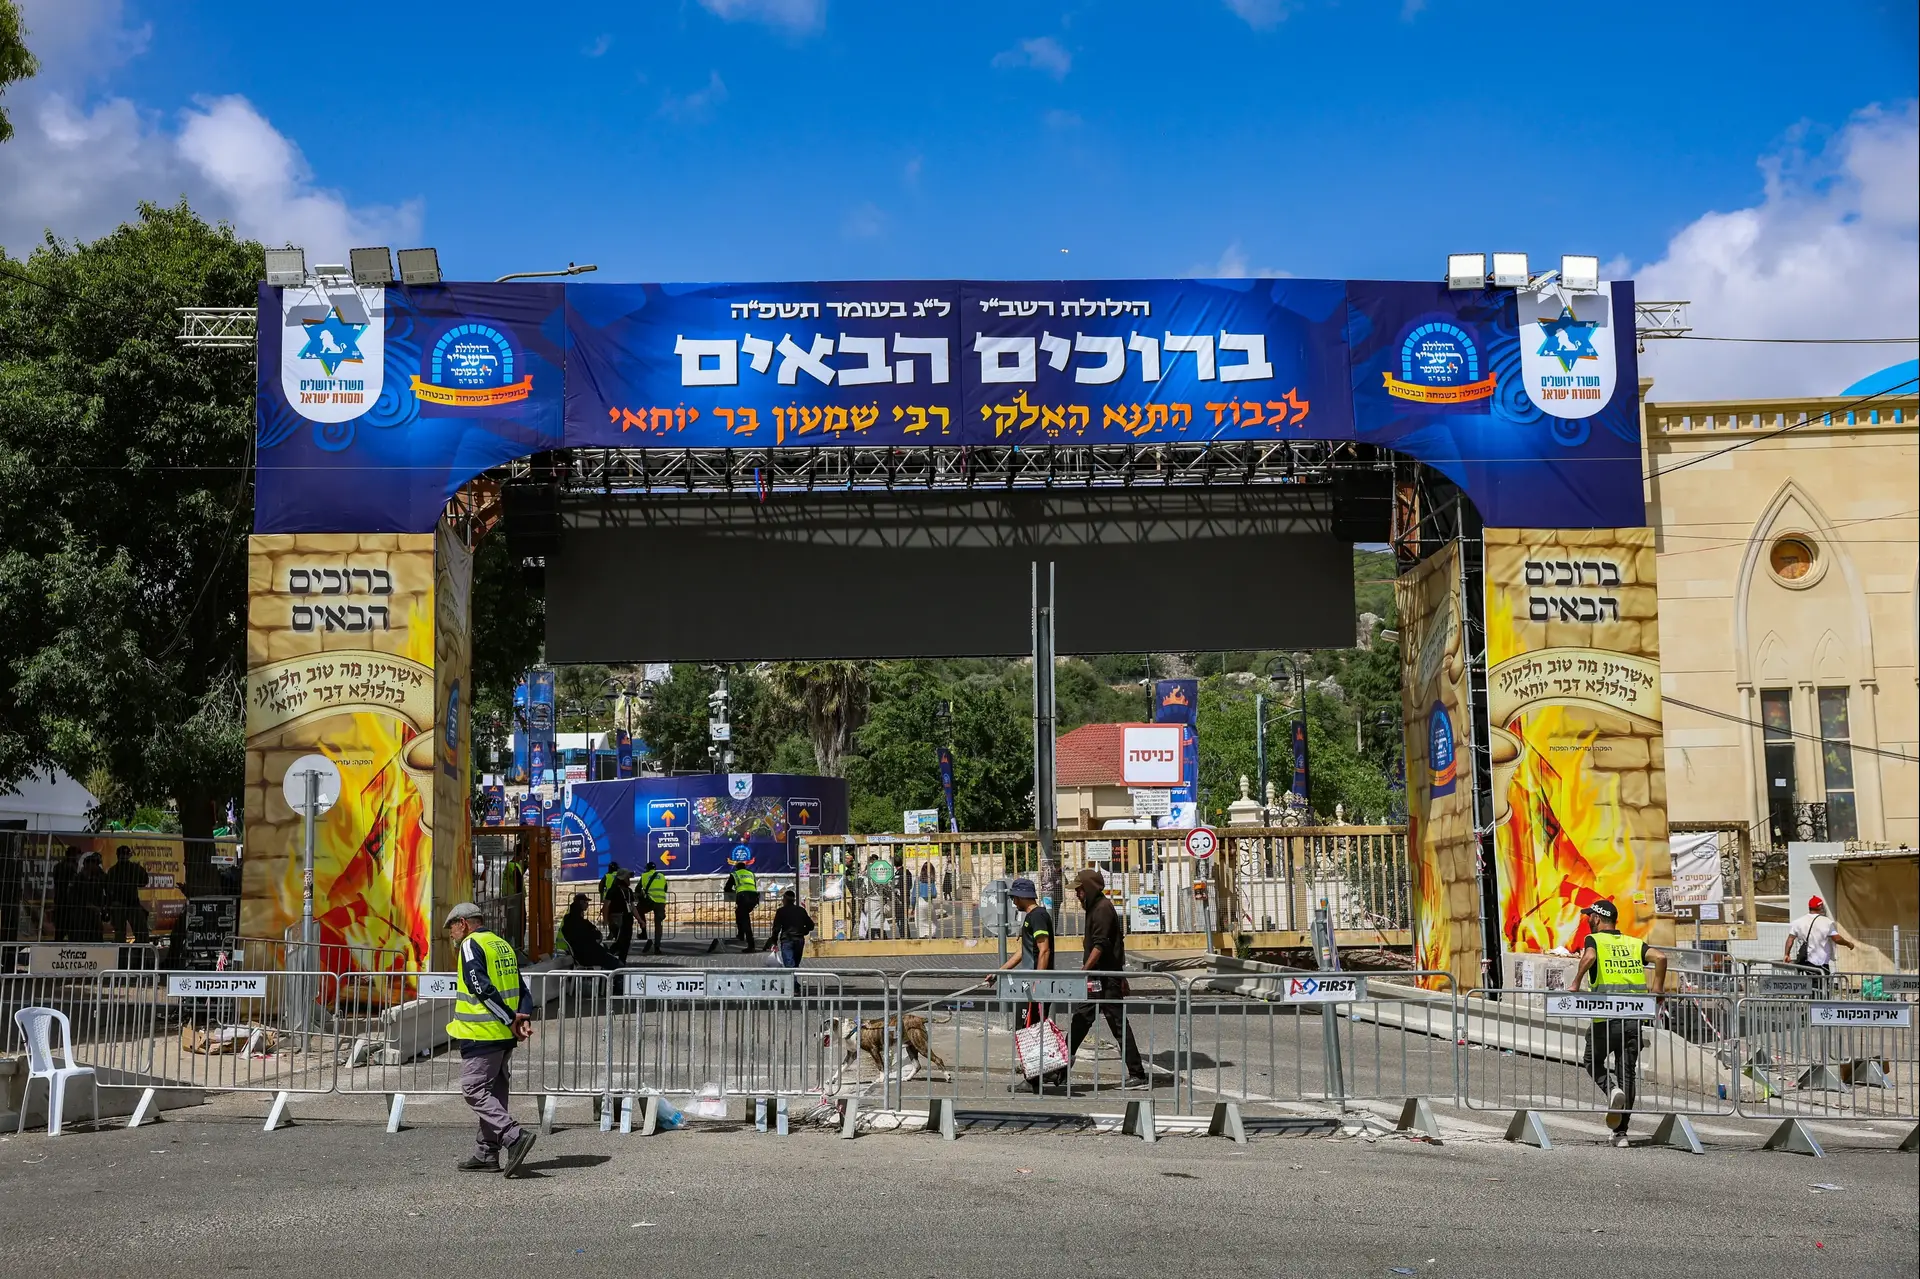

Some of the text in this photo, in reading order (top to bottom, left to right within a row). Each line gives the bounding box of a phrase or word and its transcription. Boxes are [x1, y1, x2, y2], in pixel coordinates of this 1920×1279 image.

[826, 300, 907, 318] בעומר
[1061, 298, 1150, 317] הילולת
[454, 343, 490, 353] הילולת
[673, 329, 1274, 386] ברוכים הבאים
[300, 378, 364, 391] משרד ירושלים
[1541, 375, 1600, 387] משרד ירושלים
[300, 392, 364, 404] ומסורת ישראל
[1541, 388, 1601, 400] ומסורת ישראל
[1524, 560, 1621, 586] ברוכים
[289, 568, 393, 594] ברוכים
[1528, 595, 1618, 622] הבאים
[291, 604, 389, 632] הבאים
[1129, 749, 1174, 762] כניסה
[202, 904, 218, 912] NET
[195, 980, 257, 991] אריק הפקות
[676, 980, 704, 992] פקות
[1318, 980, 1356, 992] FIRST
[1773, 981, 1807, 991] אריק הפקות
[1575, 999, 1644, 1012] אריק הפקות
[1837, 1009, 1898, 1021] אריק הפקות
